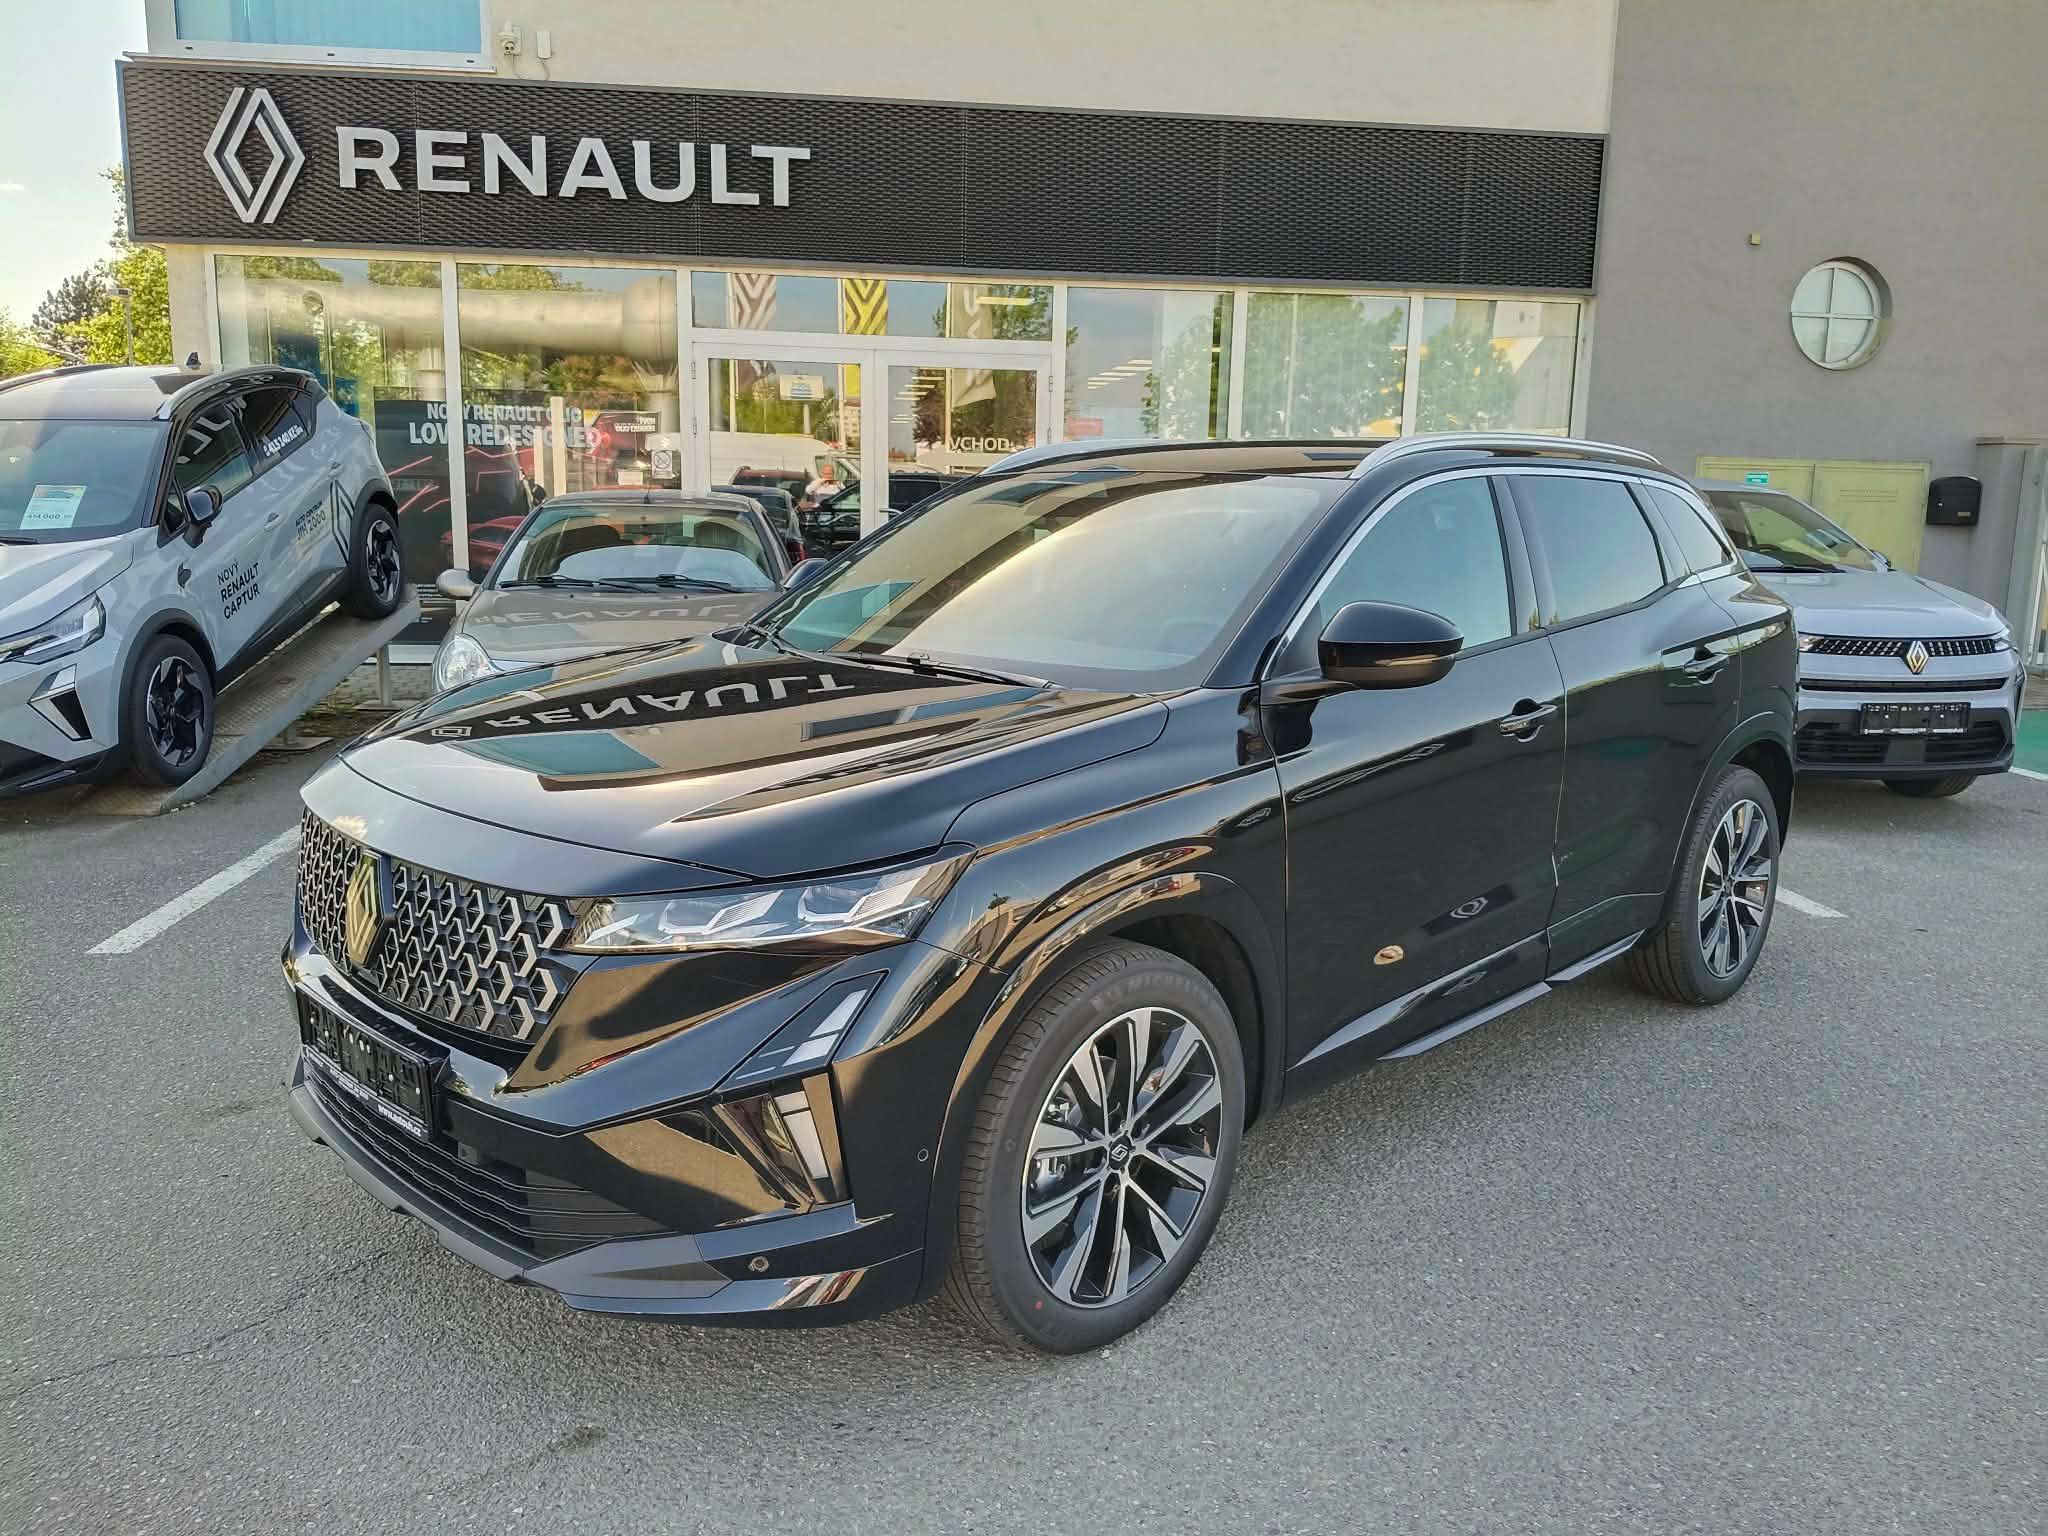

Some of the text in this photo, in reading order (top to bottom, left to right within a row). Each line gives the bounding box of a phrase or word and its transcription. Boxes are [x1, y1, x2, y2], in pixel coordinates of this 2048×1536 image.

[336, 126, 811, 207] RENAULT
[473, 404, 545, 421] RENAULT
[545, 406, 582, 423] CIO
[409, 422, 449, 445] LOV
[949, 436, 1010, 451] VCHOD
[220, 562, 259, 602] RENAULT
[223, 583, 260, 619] CAPTUR
